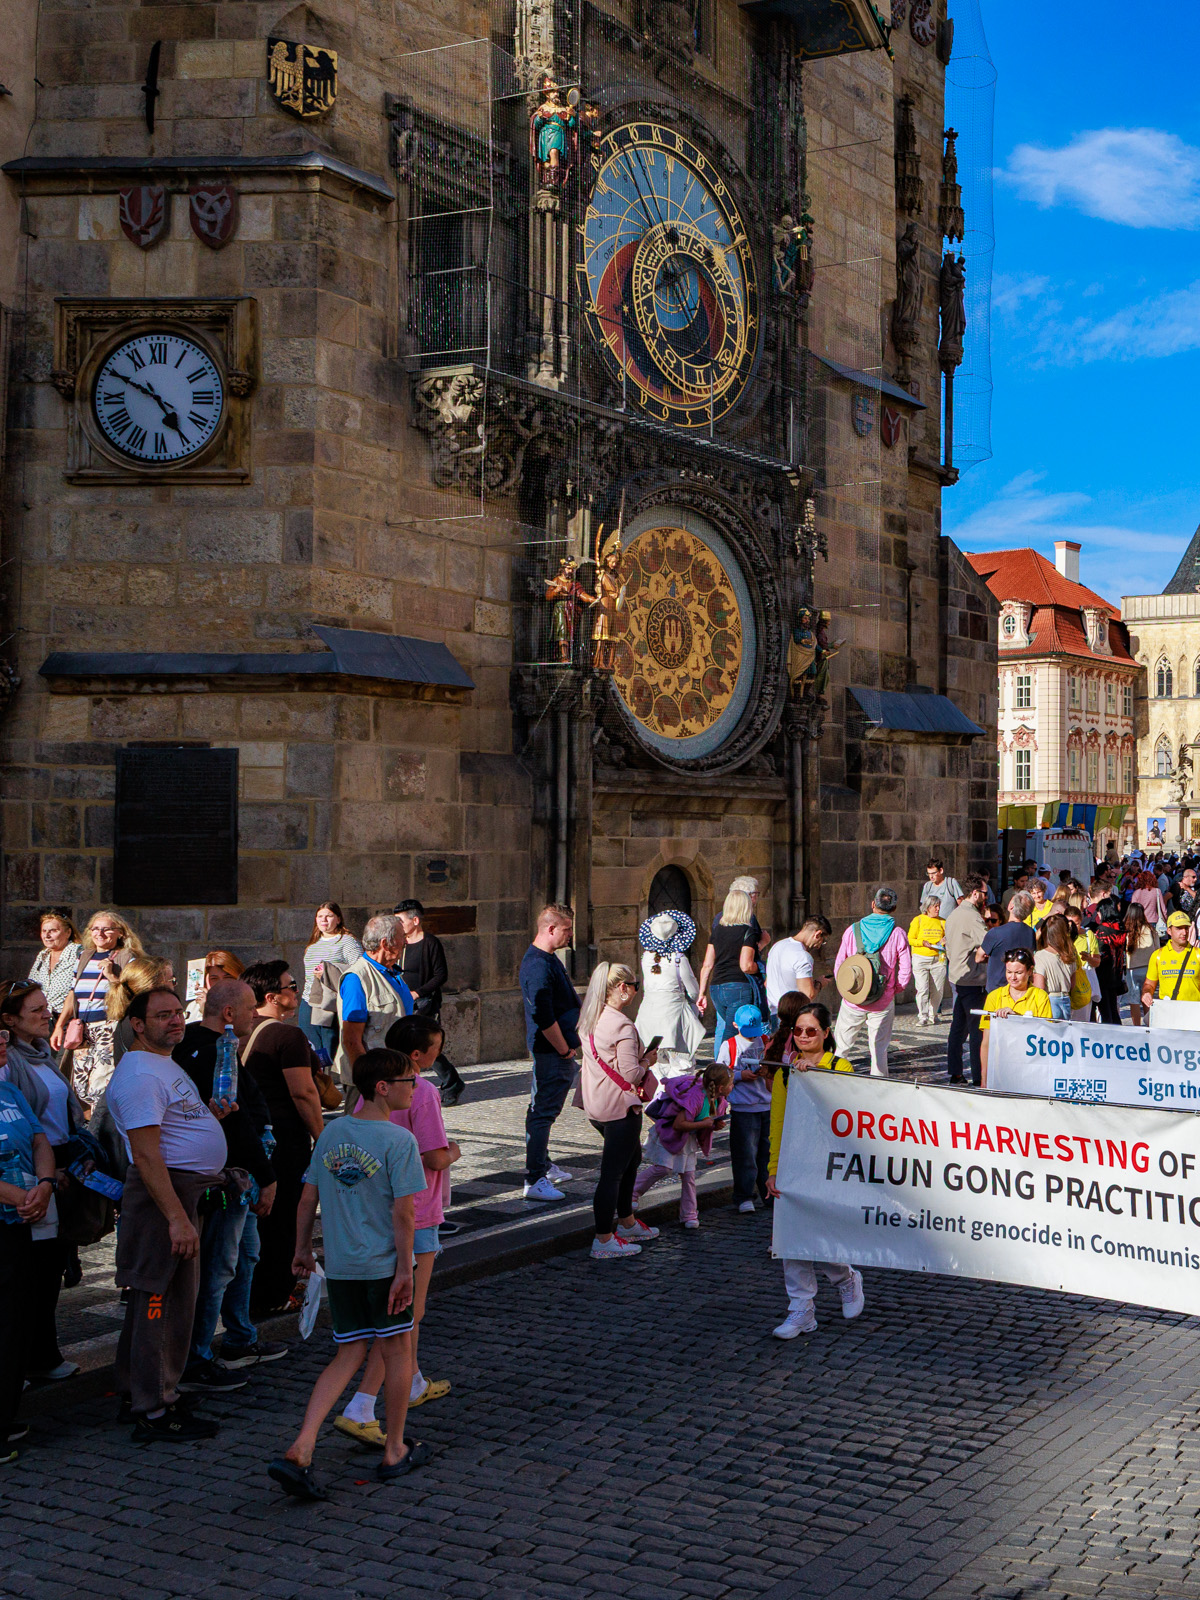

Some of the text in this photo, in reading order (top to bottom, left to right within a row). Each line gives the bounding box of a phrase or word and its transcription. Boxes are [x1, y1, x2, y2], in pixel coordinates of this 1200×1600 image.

[126, 348, 147, 372] XI
[149, 343, 168, 365] XII
[174, 349, 188, 369] I
[186, 366, 208, 385] II
[104, 391, 125, 405] IX
[192, 390, 214, 405] III
[107, 408, 134, 437] VIII
[126, 425, 148, 451] VII
[155, 432, 168, 454] VI
[1025, 1033, 1075, 1064] Stop
[1080, 1037, 1151, 1063] Forced
[1138, 1077, 1175, 1102] Sign
[830, 1108, 940, 1148] ORGAN
[949, 1120, 1151, 1174] HARVESTING
[1158, 1150, 1196, 1180] OF
[321, 1143, 384, 1179] CALIFORNIA
[825, 1151, 933, 1189] FALUN
[943, 1162, 1036, 1201] GONG
[861, 1205, 902, 1228] The
[906, 1208, 967, 1235] silent
[970, 1219, 1063, 1248] genocide
[1067, 1227, 1086, 1252] in
